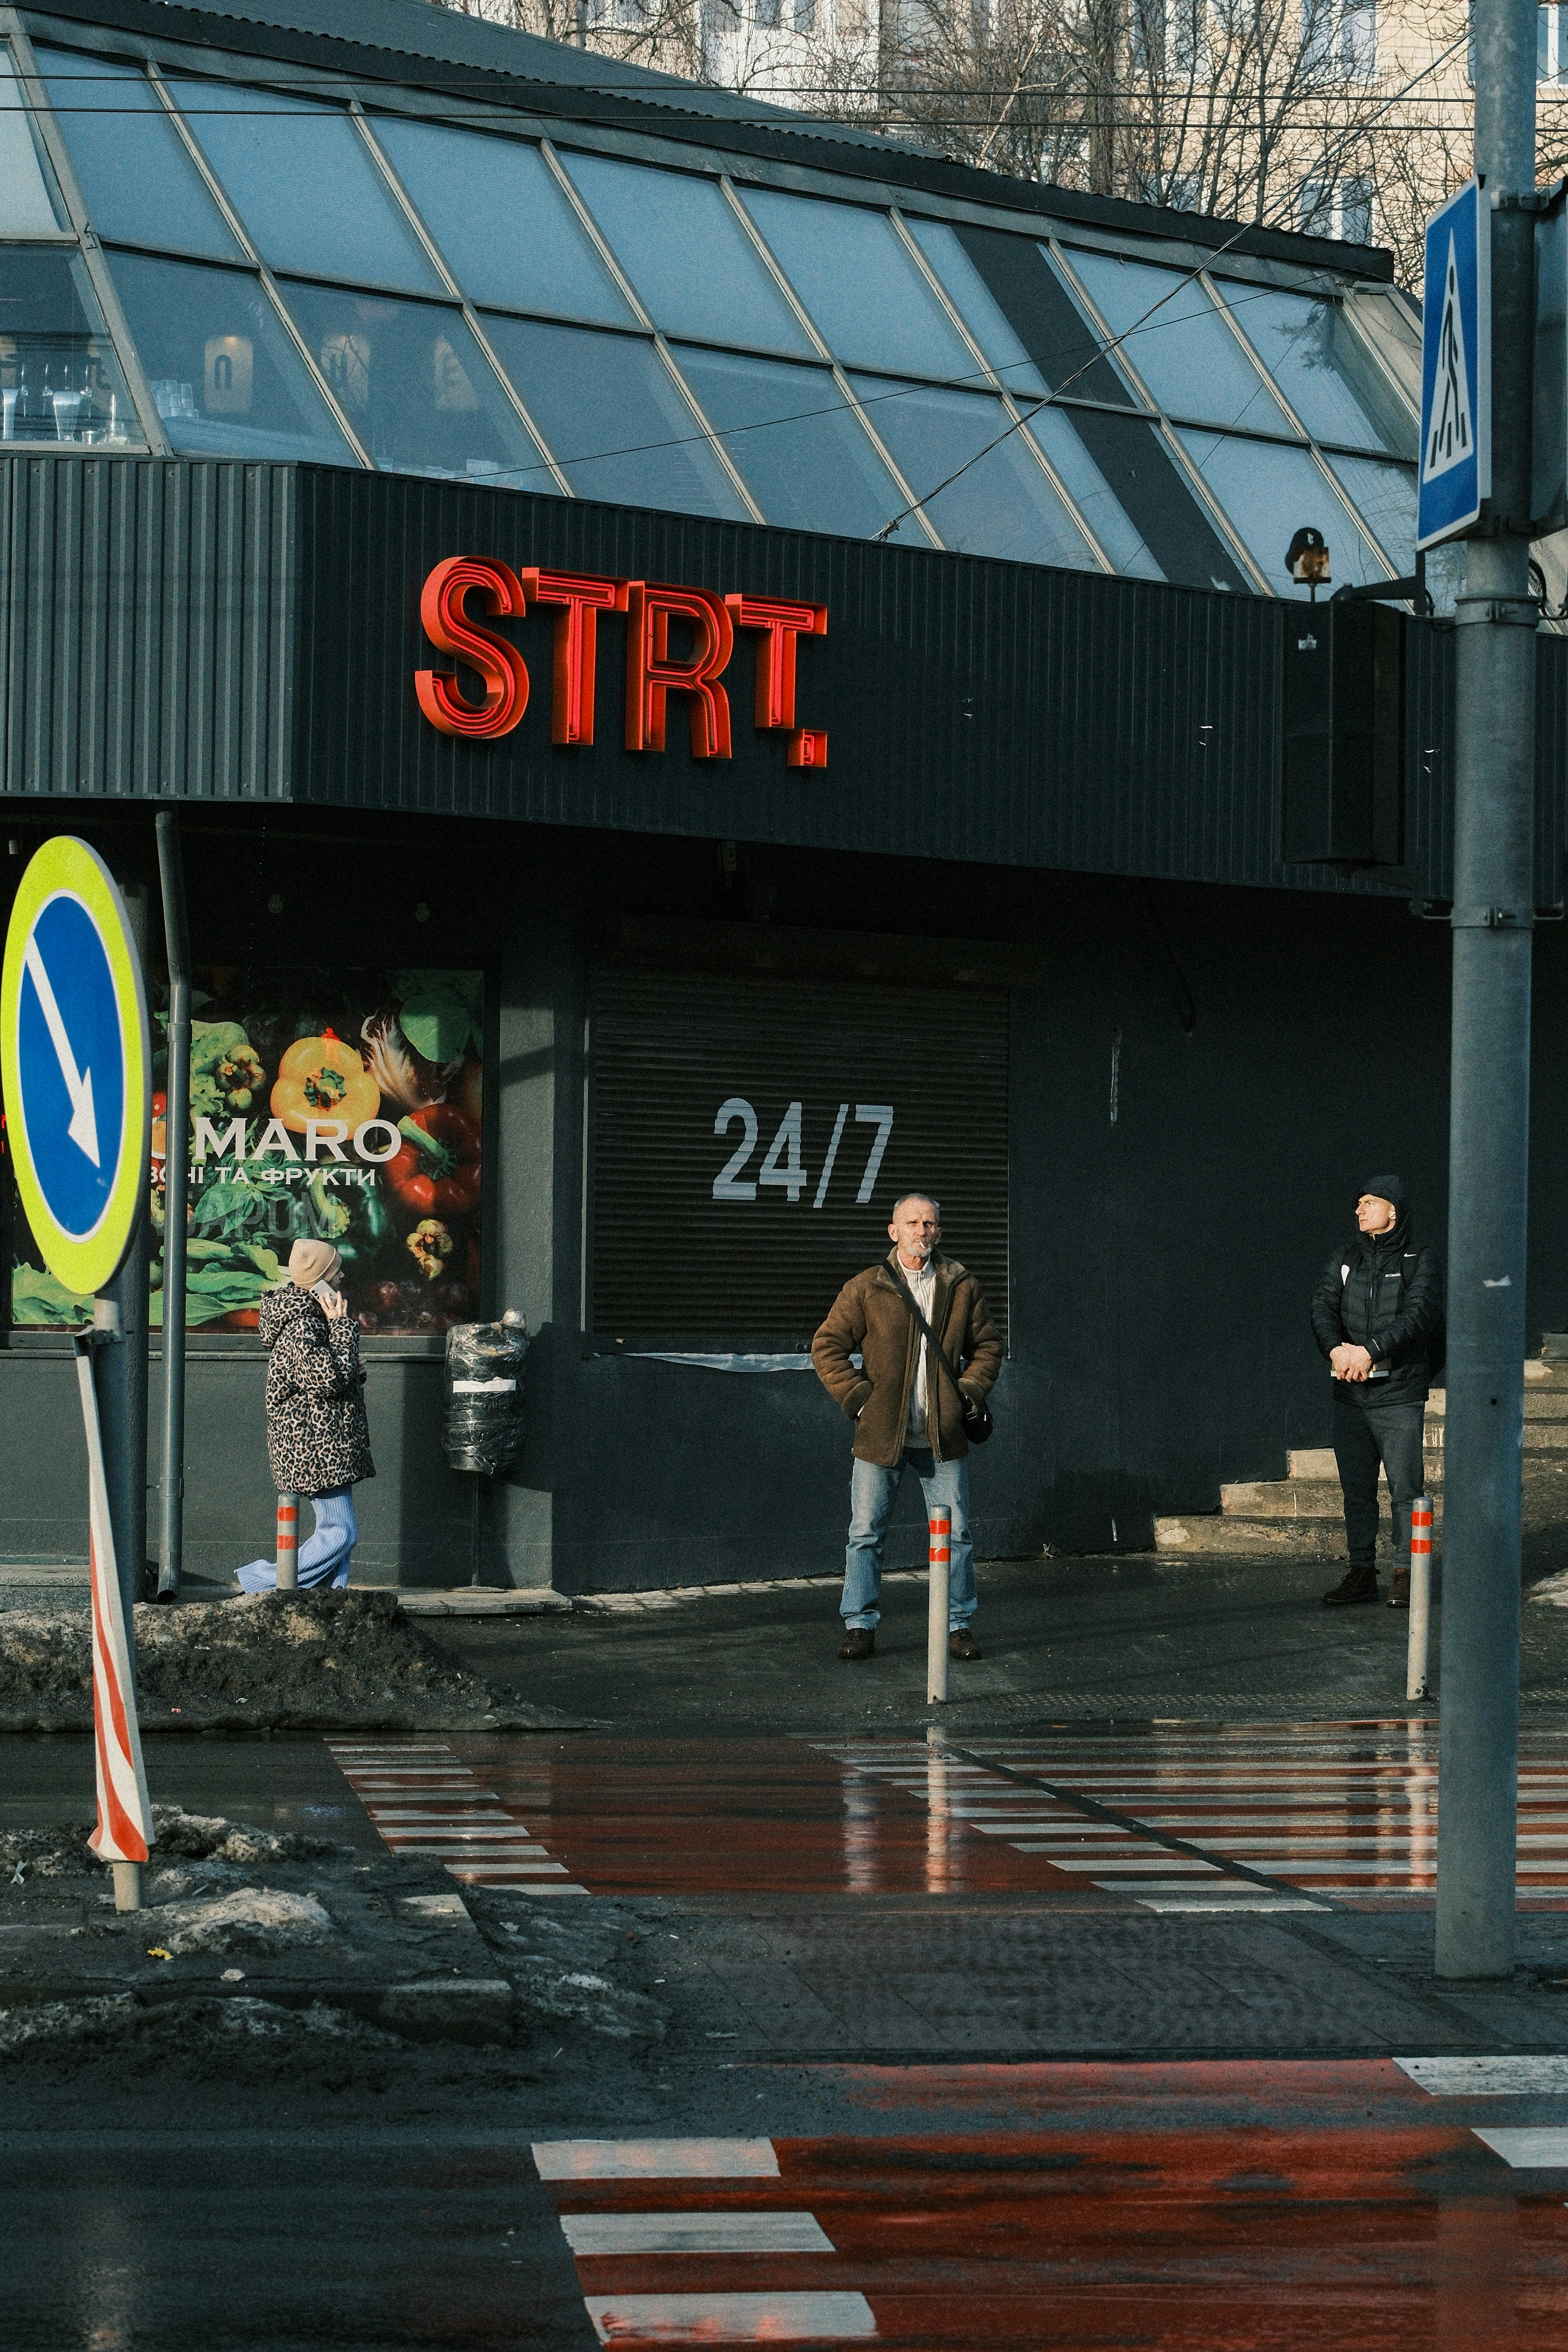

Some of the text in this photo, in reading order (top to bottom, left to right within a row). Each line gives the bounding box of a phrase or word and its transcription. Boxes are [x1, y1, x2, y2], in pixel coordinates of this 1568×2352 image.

[415, 556, 827, 768] STRT.
[215, 1167, 250, 1184] ТА
[261, 1168, 375, 1186] ФРУКТИ
[713, 1098, 893, 1208] 24/7
